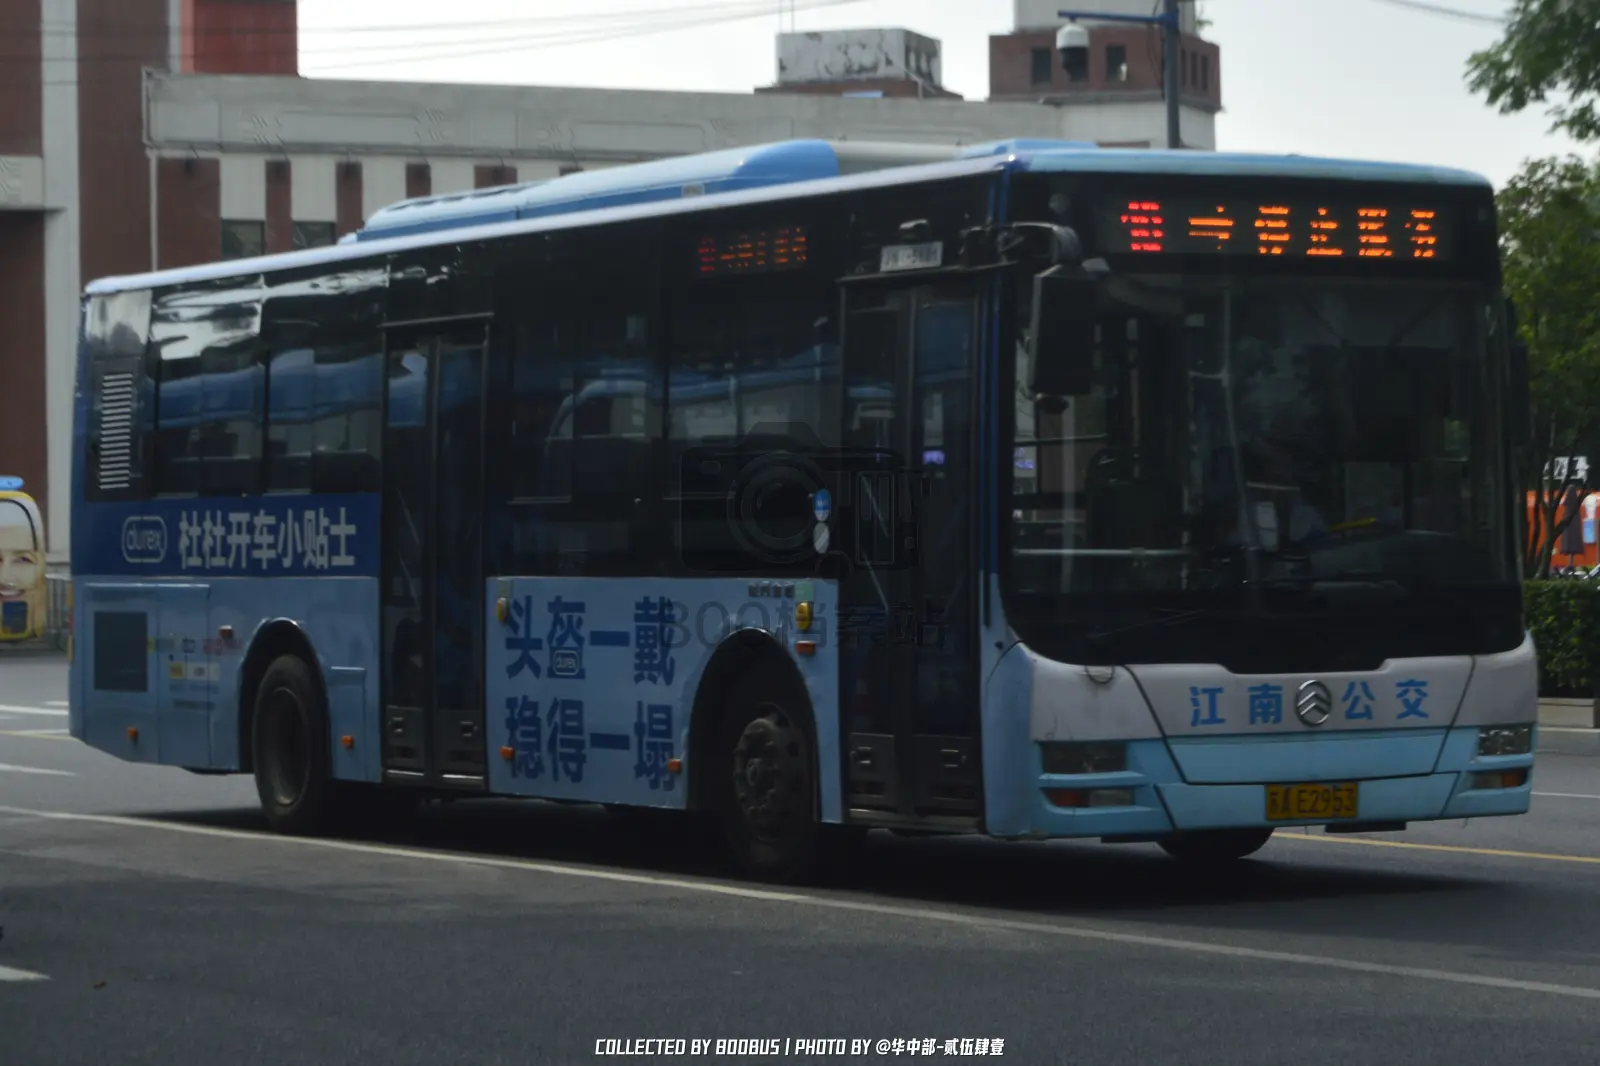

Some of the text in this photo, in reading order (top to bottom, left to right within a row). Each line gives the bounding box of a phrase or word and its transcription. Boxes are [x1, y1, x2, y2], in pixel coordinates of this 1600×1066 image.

[125, 521, 166, 553] durex
[178, 506, 357, 570] 杜杜开车小贴士
[504, 694, 675, 792] 稳得一塌
